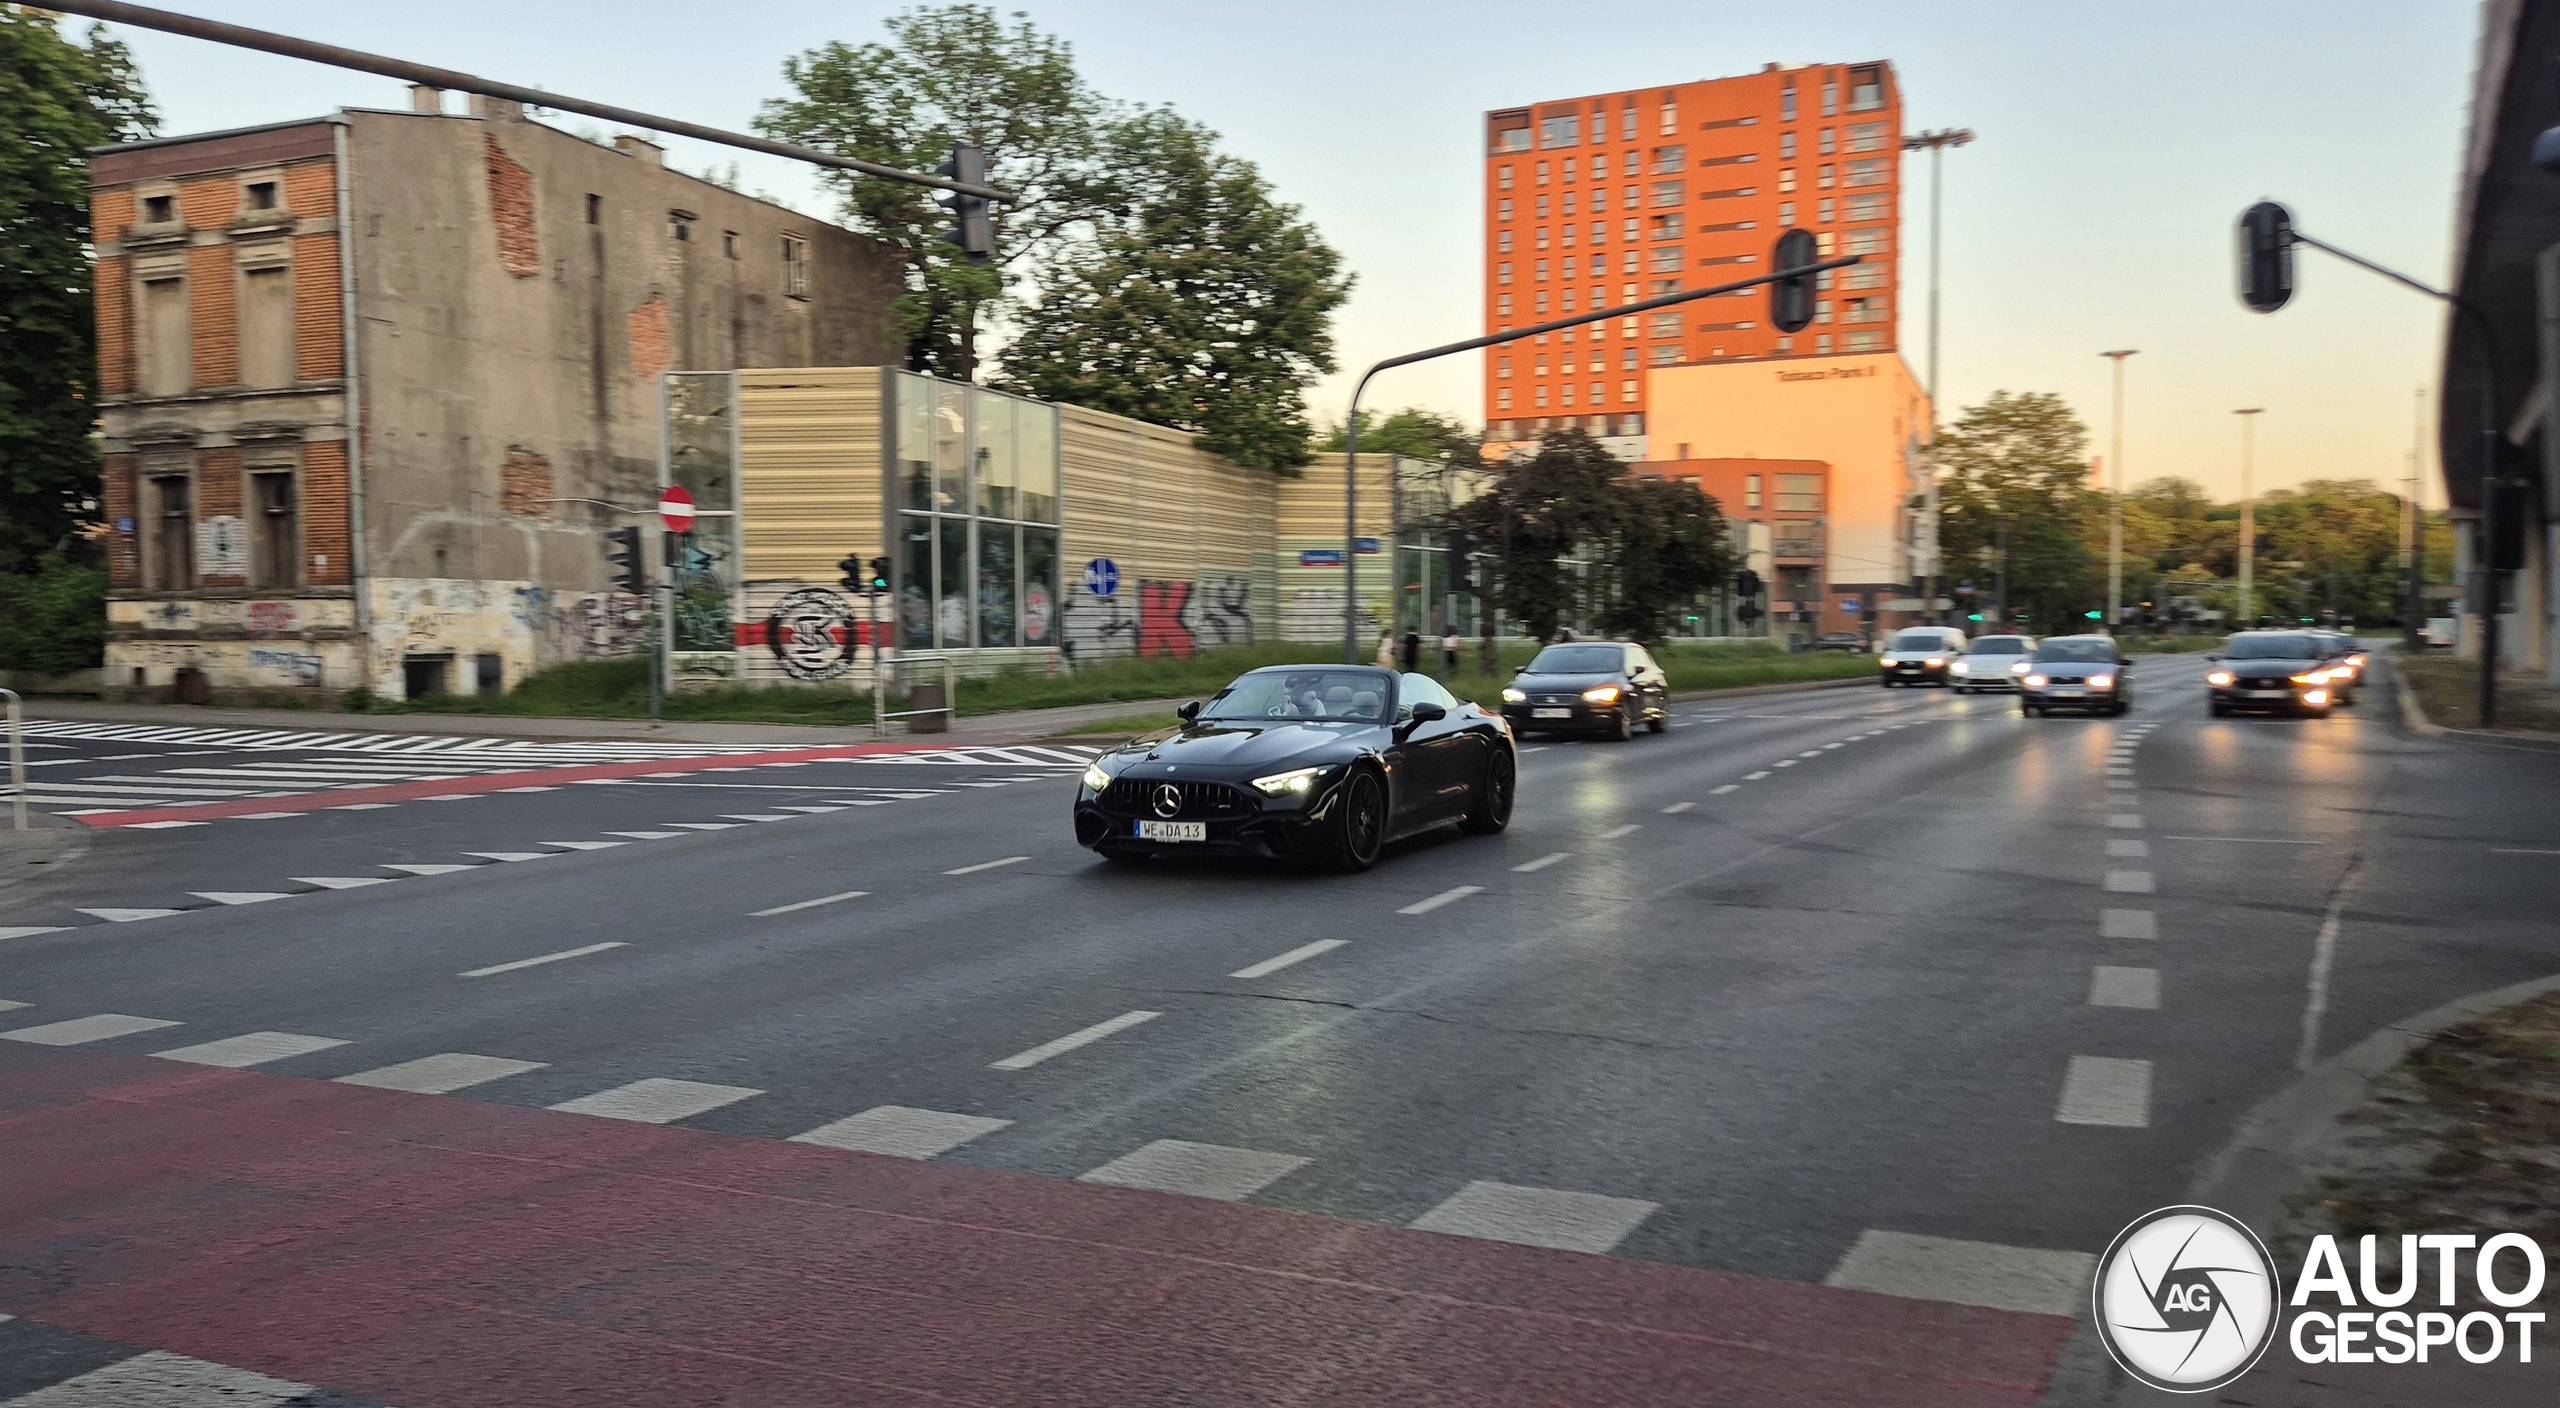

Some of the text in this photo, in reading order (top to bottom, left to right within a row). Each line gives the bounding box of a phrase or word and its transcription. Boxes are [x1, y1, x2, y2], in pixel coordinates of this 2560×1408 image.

[1143, 822, 1200, 838] WE DA 13
